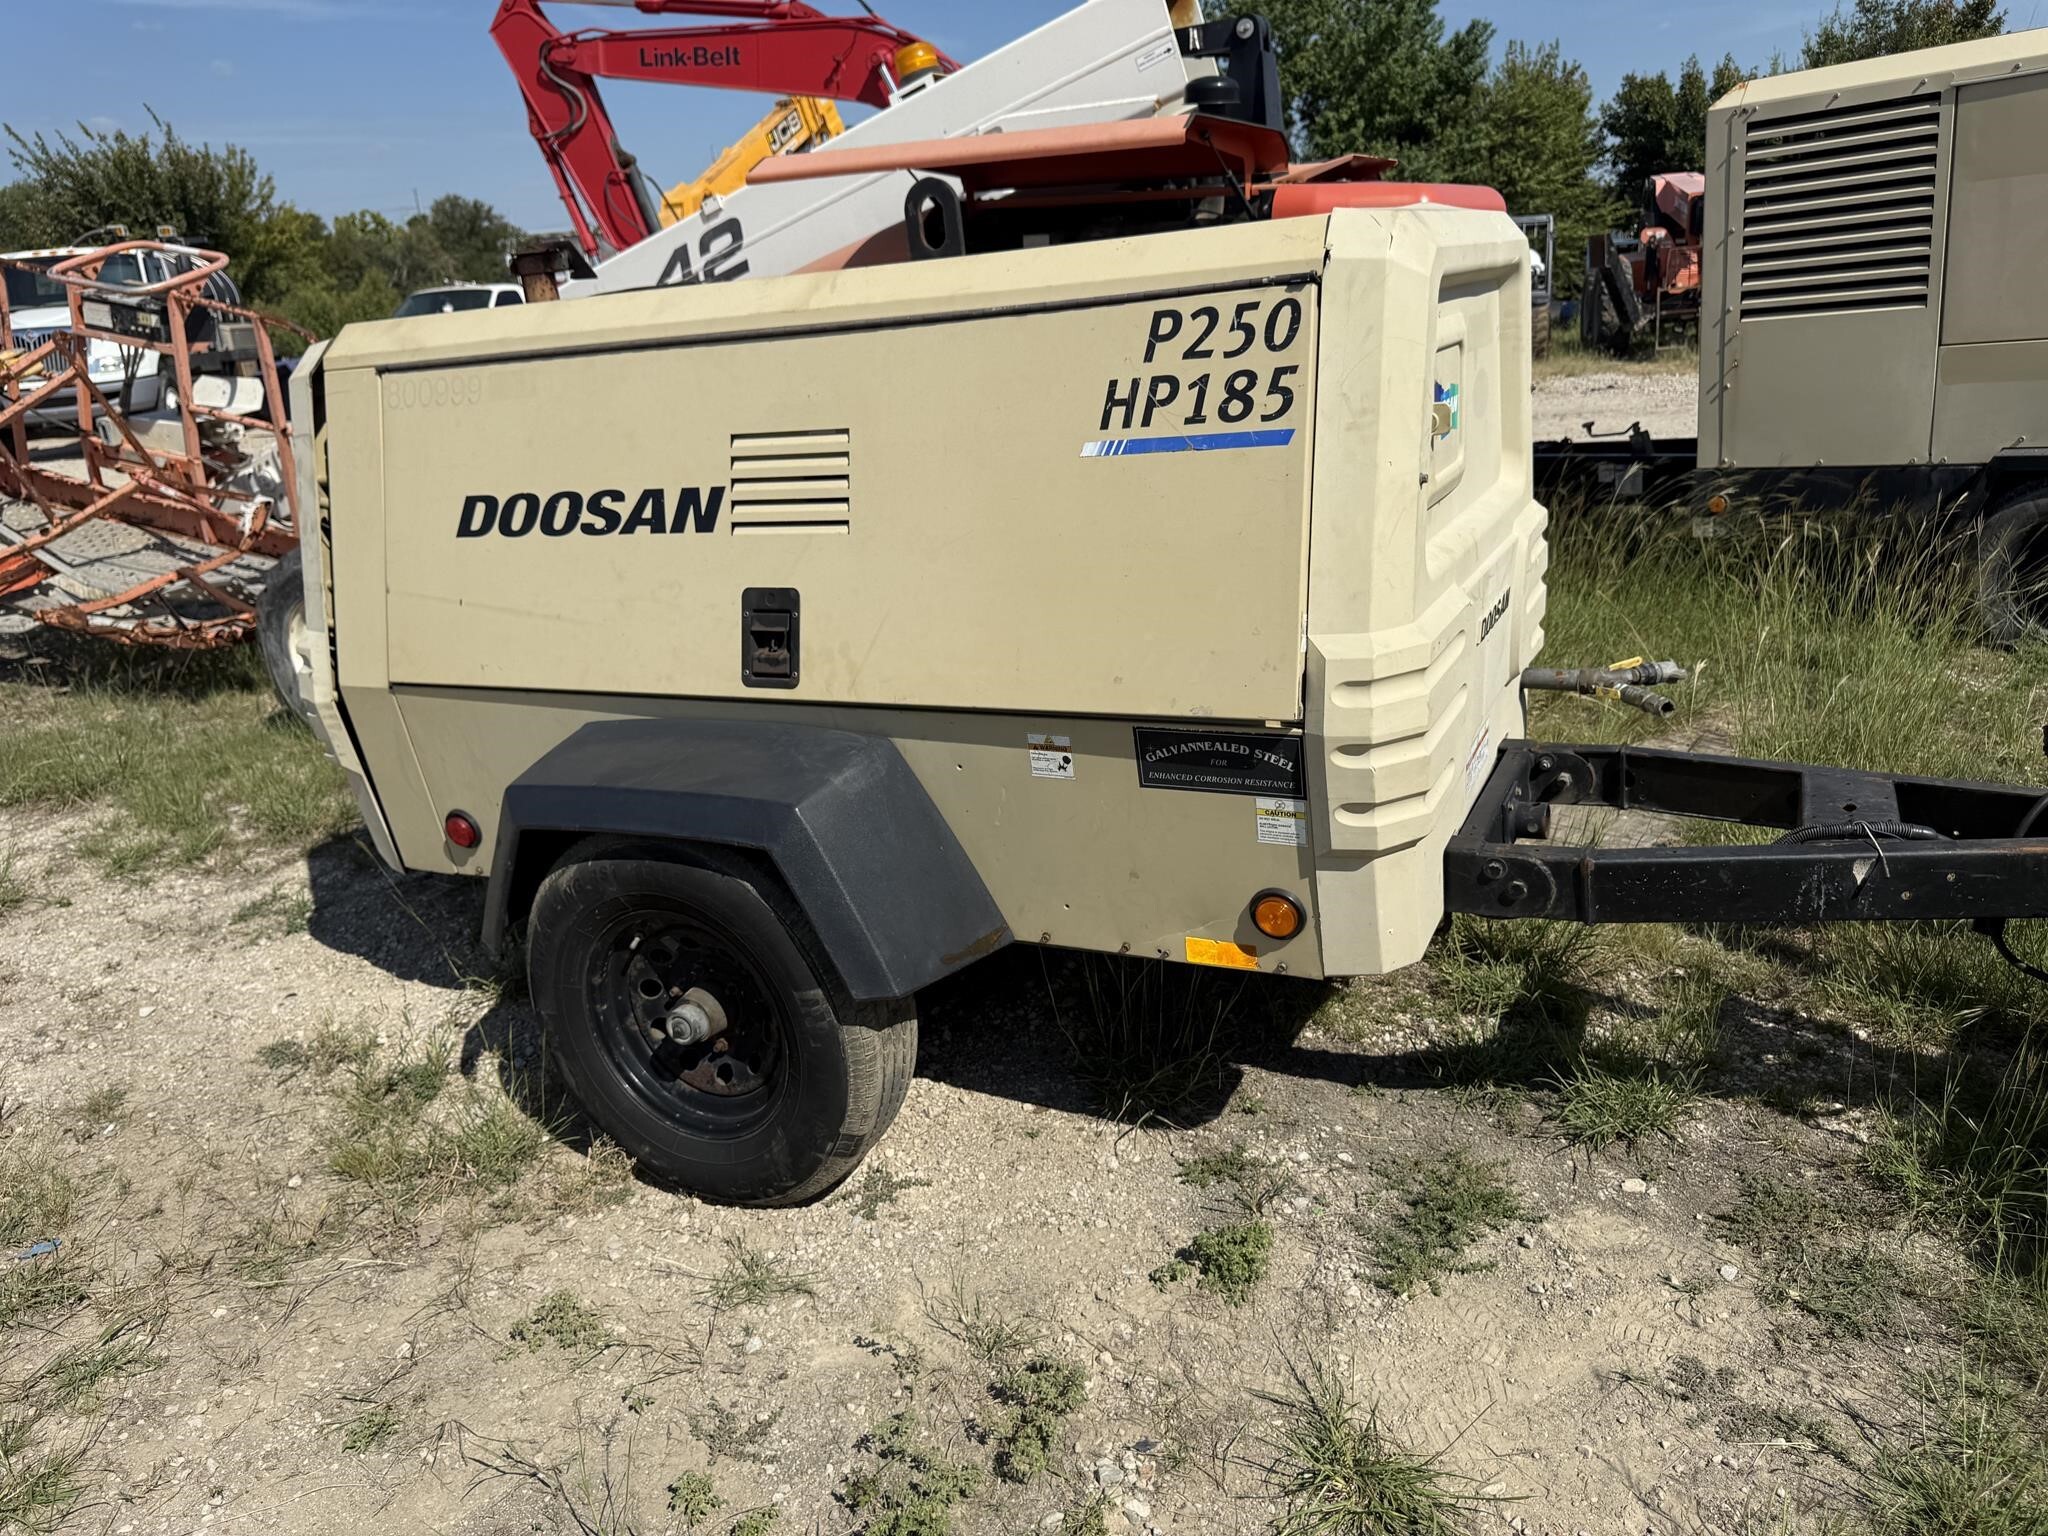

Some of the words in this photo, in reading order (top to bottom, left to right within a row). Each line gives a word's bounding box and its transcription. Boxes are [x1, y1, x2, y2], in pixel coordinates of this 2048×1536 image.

[769, 108, 801, 151] JCB
[656, 217, 750, 286] 42
[1143, 298, 1302, 363] P250
[387, 374, 482, 409] 800999
[1099, 365, 1300, 430] HP185
[456, 486, 726, 538] DOOSAN
[1480, 586, 1511, 642] DOOSAN
[1145, 741, 1250, 762] GALVANNEALED
[1253, 749, 1295, 772] STEEL
[1210, 758, 1228, 767] FOR
[1148, 771, 1193, 781] ENHANCED
[1194, 774, 1242, 785] CORROSION
[1244, 778, 1295, 789] RESISTANCE
[1264, 809, 1297, 818] CAUTION
